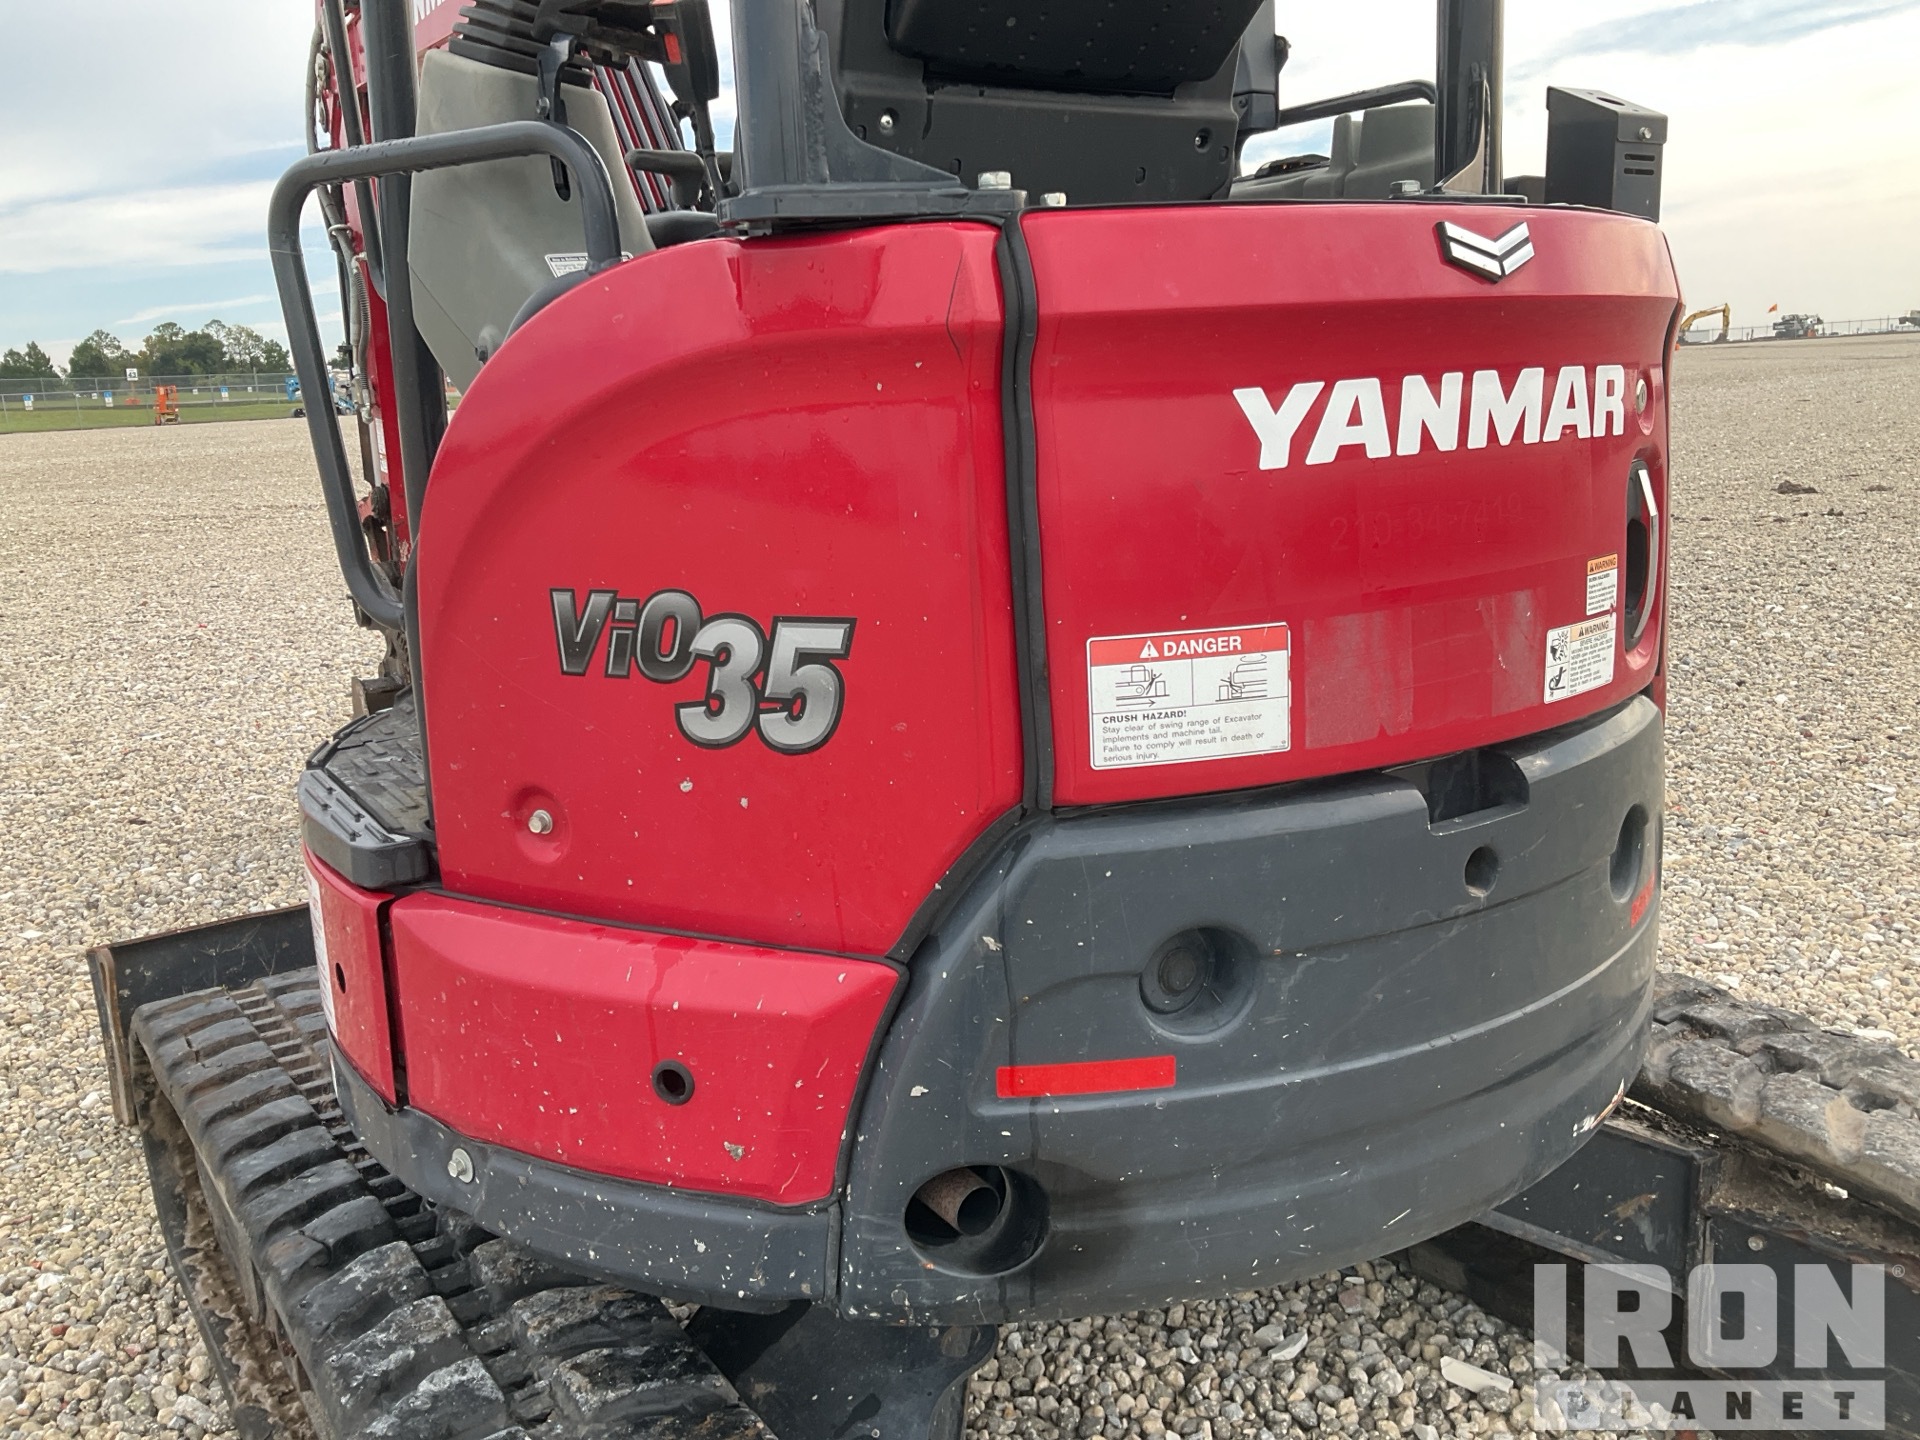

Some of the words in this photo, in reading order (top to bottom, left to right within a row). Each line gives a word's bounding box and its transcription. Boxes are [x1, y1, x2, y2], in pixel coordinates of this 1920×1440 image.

[1232, 364, 1626, 471] YANMAR
[1594, 556, 1616, 570] WARNING
[1584, 620, 1609, 636] WARNING
[1163, 635, 1242, 657] DANGER
[1102, 714, 1138, 724] CRUSH
[1142, 710, 1187, 721] HAZARD!
[1102, 726, 1120, 734] Stay
[1124, 724, 1144, 732] clear
[1160, 721, 1184, 730] swing
[1187, 719, 1209, 728] range
[1212, 716, 1221, 724] of
[1224, 713, 1262, 724] Excavator
[1102, 734, 1150, 744] implements
[1152, 731, 1168, 739] and
[1172, 728, 1205, 738] machine
[1208, 726, 1222, 734] tail.
[1103, 744, 1130, 753] Failure
[1134, 743, 1142, 751] to
[1146, 740, 1175, 750] comply
[1179, 738, 1192, 746] will
[1196, 737, 1216, 745] result
[1230, 733, 1253, 742] death
[1103, 754, 1132, 762] serious
[1136, 752, 1160, 760] injury.
